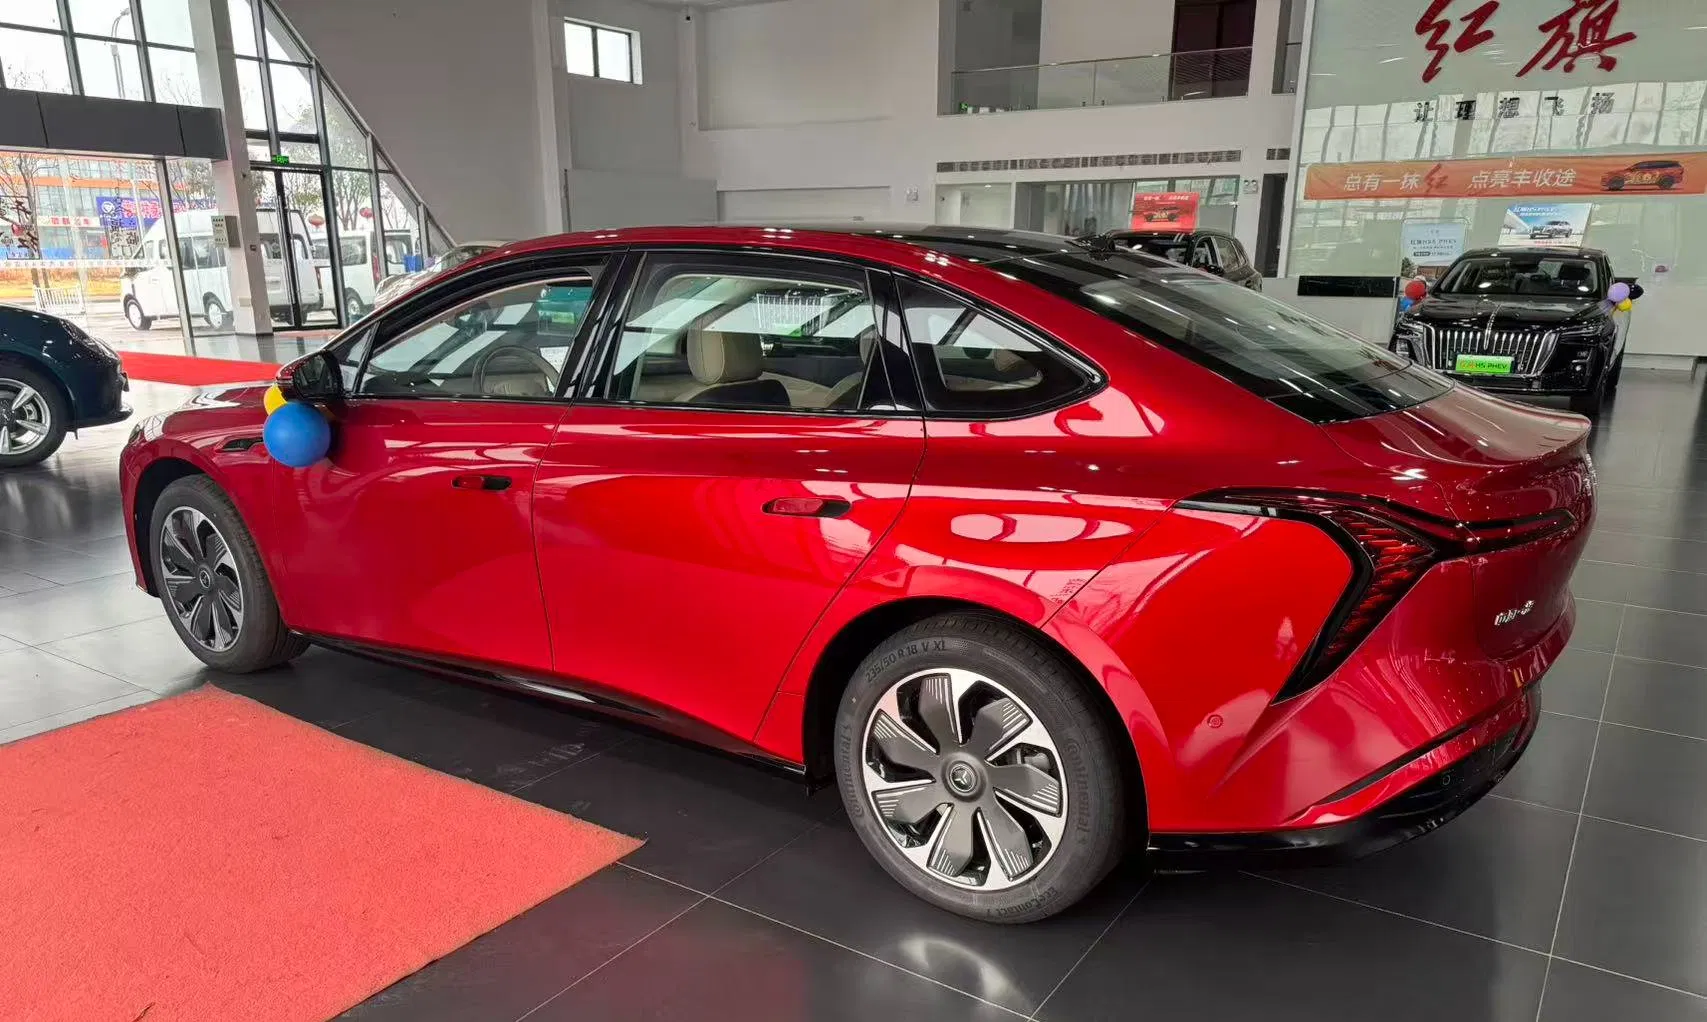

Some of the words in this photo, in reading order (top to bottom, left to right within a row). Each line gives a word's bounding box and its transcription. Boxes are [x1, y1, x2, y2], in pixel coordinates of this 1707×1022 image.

[1416, 0, 1637, 83] 红旗
[1414, 92, 1615, 123] 让理想飞扬
[1467, 167, 1577, 190] 点亮丰收途
[865, 652, 897, 683] 235/50
